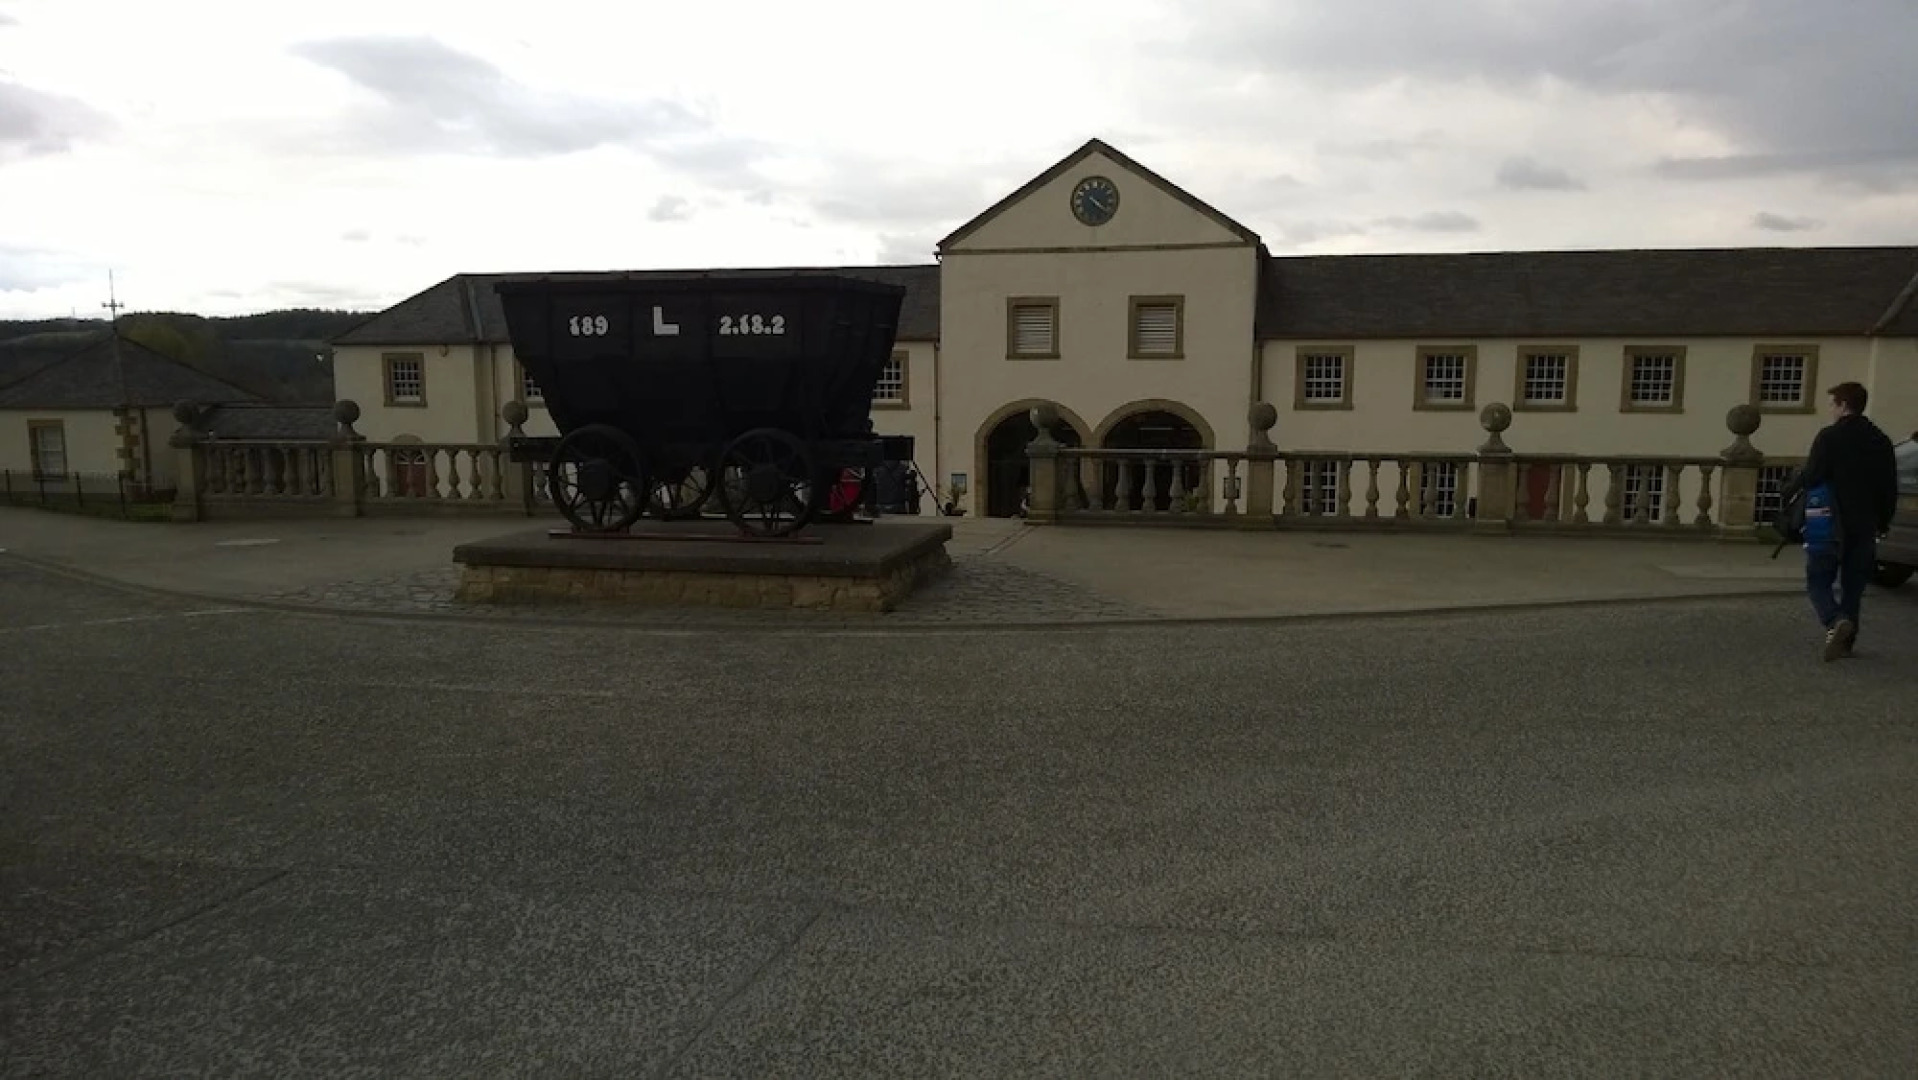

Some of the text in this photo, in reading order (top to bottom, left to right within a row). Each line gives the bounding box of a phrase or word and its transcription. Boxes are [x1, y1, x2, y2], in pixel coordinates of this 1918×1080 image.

[569, 306, 785, 335] 189 L 2.18.2
